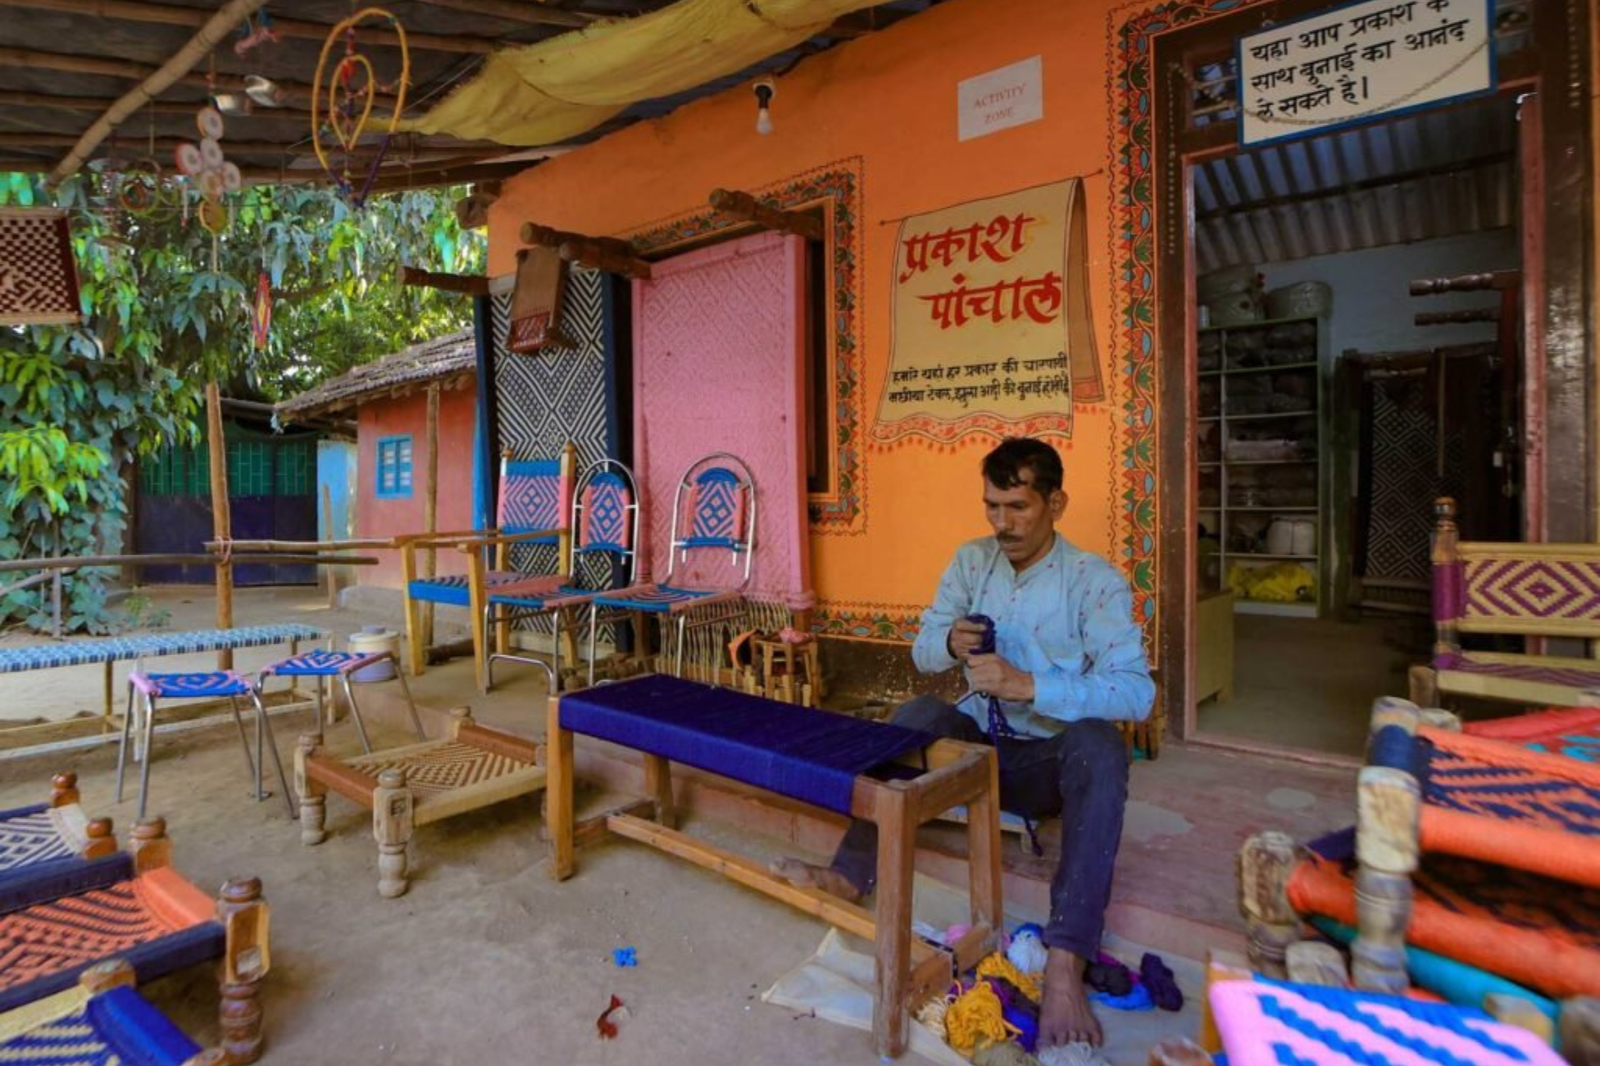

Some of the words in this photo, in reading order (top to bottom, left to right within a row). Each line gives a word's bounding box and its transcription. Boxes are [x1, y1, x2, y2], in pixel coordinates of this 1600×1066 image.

[1299, 23, 1344, 49] आप
[1349, 1, 1419, 37] प्रकाश
[1250, 65, 1297, 93] साथ
[1361, 39, 1397, 62] का
[1403, 18, 1470, 51] आनंद
[975, 82, 1026, 108] ACTIVITY
[1255, 98, 1275, 122] ले
[1278, 84, 1334, 117] सकते
[984, 105, 1014, 124] ZONE
[899, 212, 1037, 284] प्रकाश
[916, 271, 1062, 330] पांचाल
[892, 366, 919, 384] हमारे
[946, 366, 961, 381] हर
[964, 362, 998, 378] प्रकार
[1002, 356, 1019, 374] की
[1002, 377, 1017, 396] की
